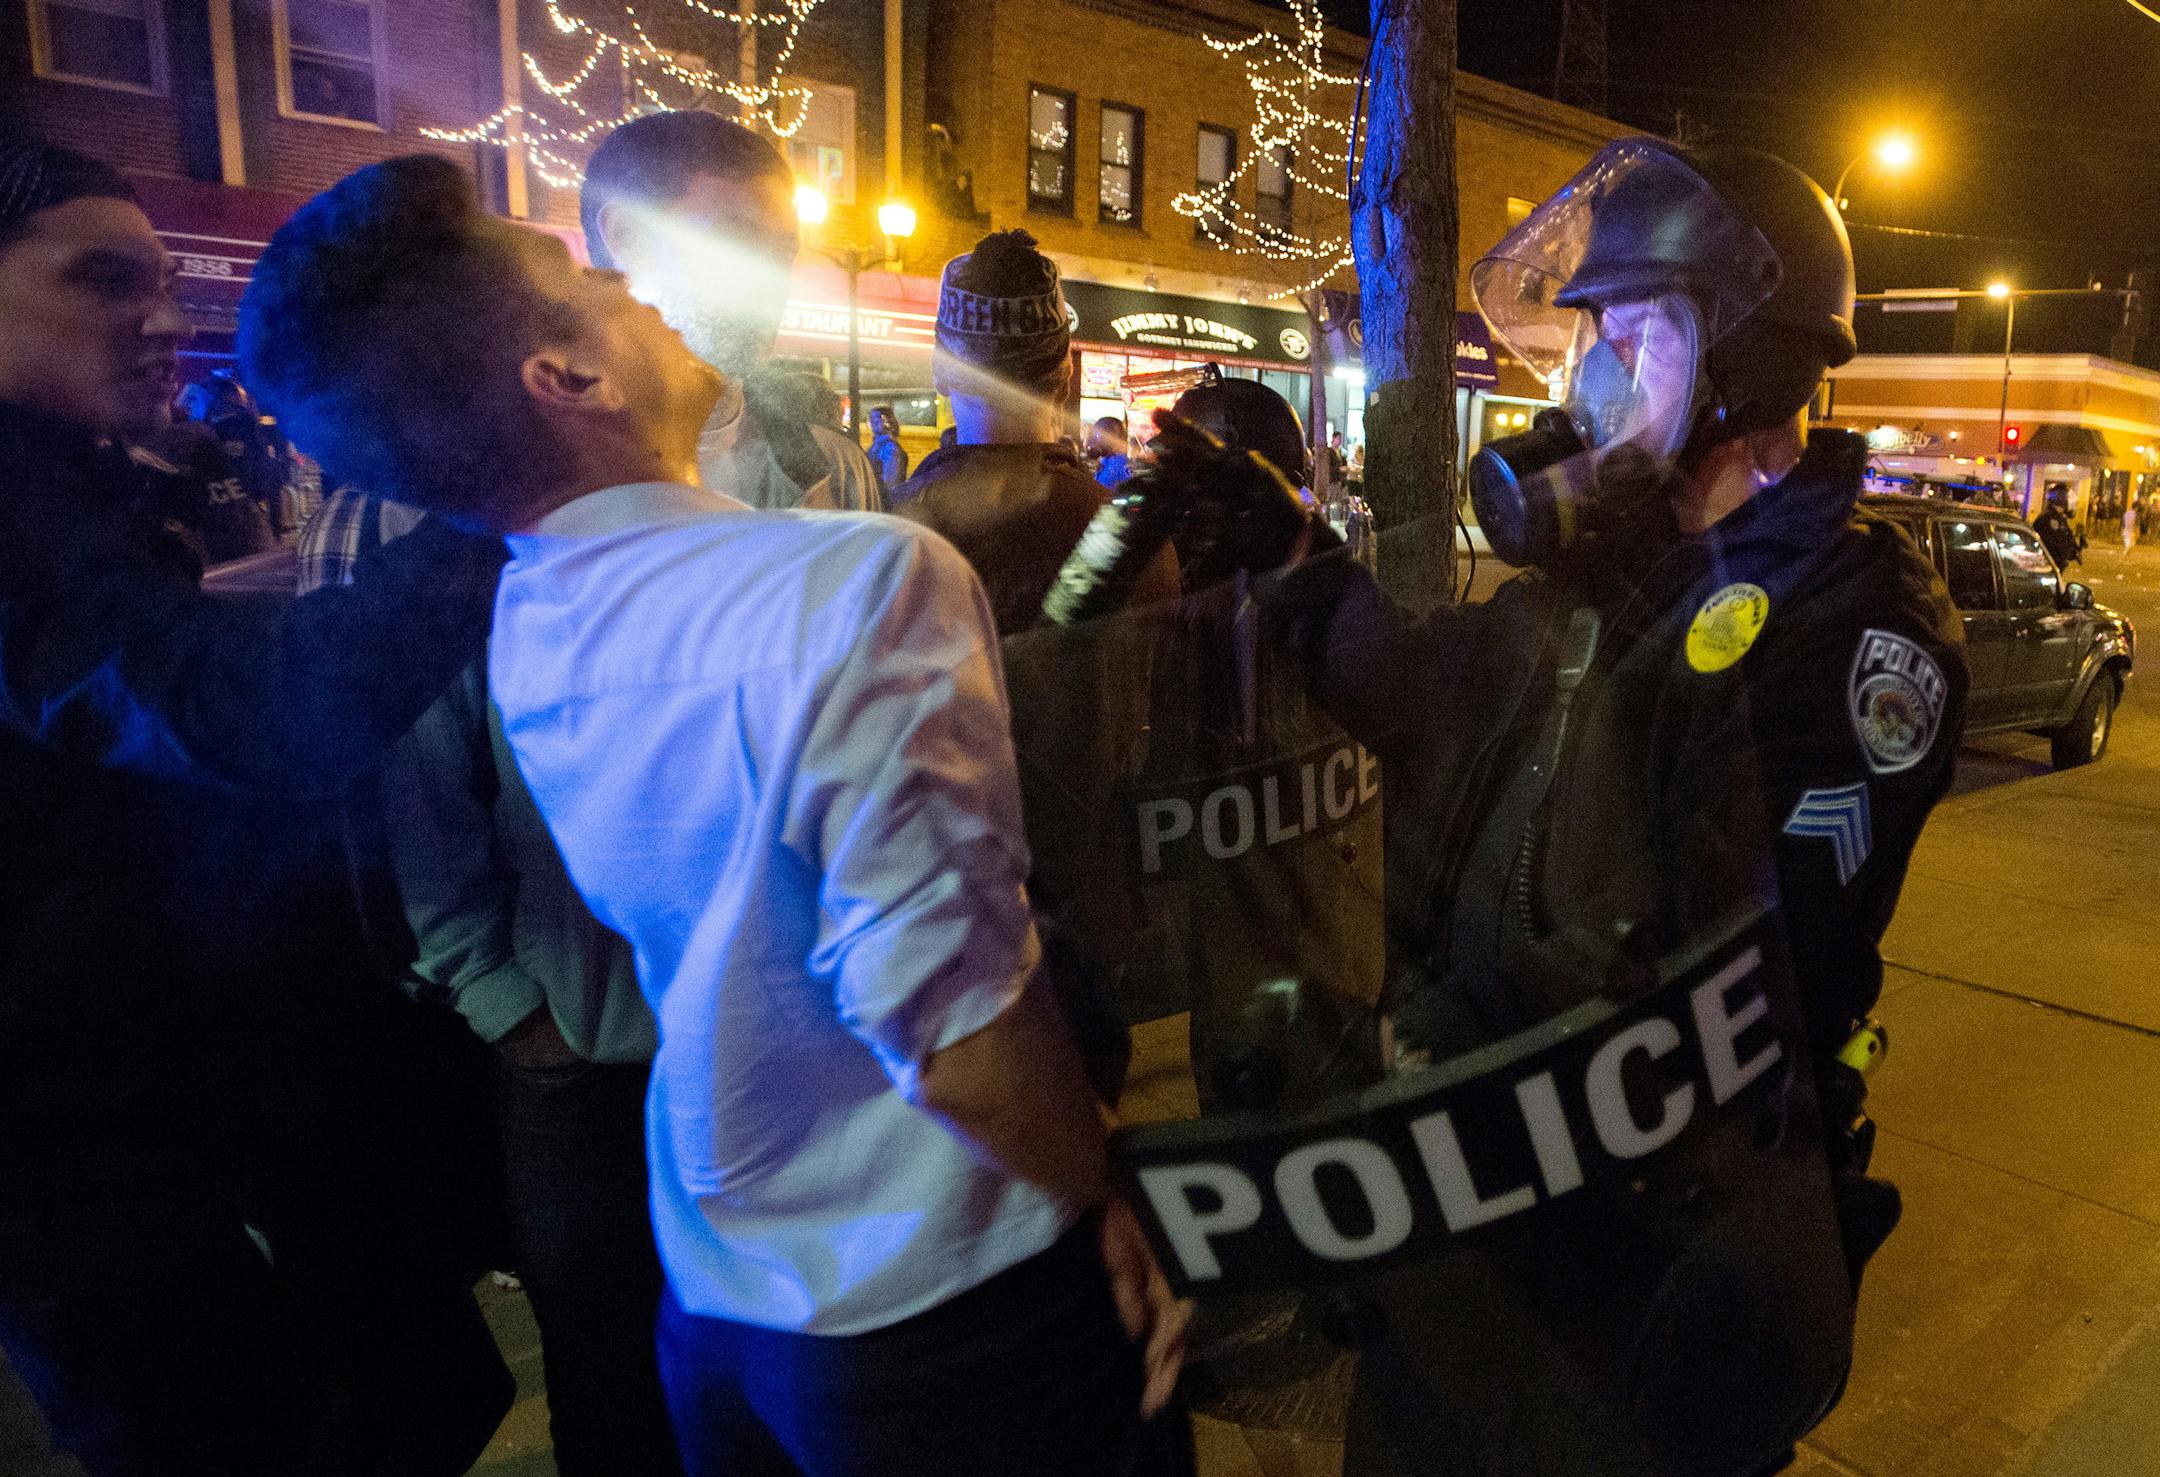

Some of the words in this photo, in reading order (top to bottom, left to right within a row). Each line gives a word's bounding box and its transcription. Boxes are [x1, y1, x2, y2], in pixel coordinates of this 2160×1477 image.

[1110, 312, 1180, 340] JIMMY
[1183, 315, 1259, 350] JOHN'S
[1863, 637, 1945, 719] POLICE
[1137, 740, 1379, 874] POLICE
[1137, 945, 1782, 1282] POLICE
